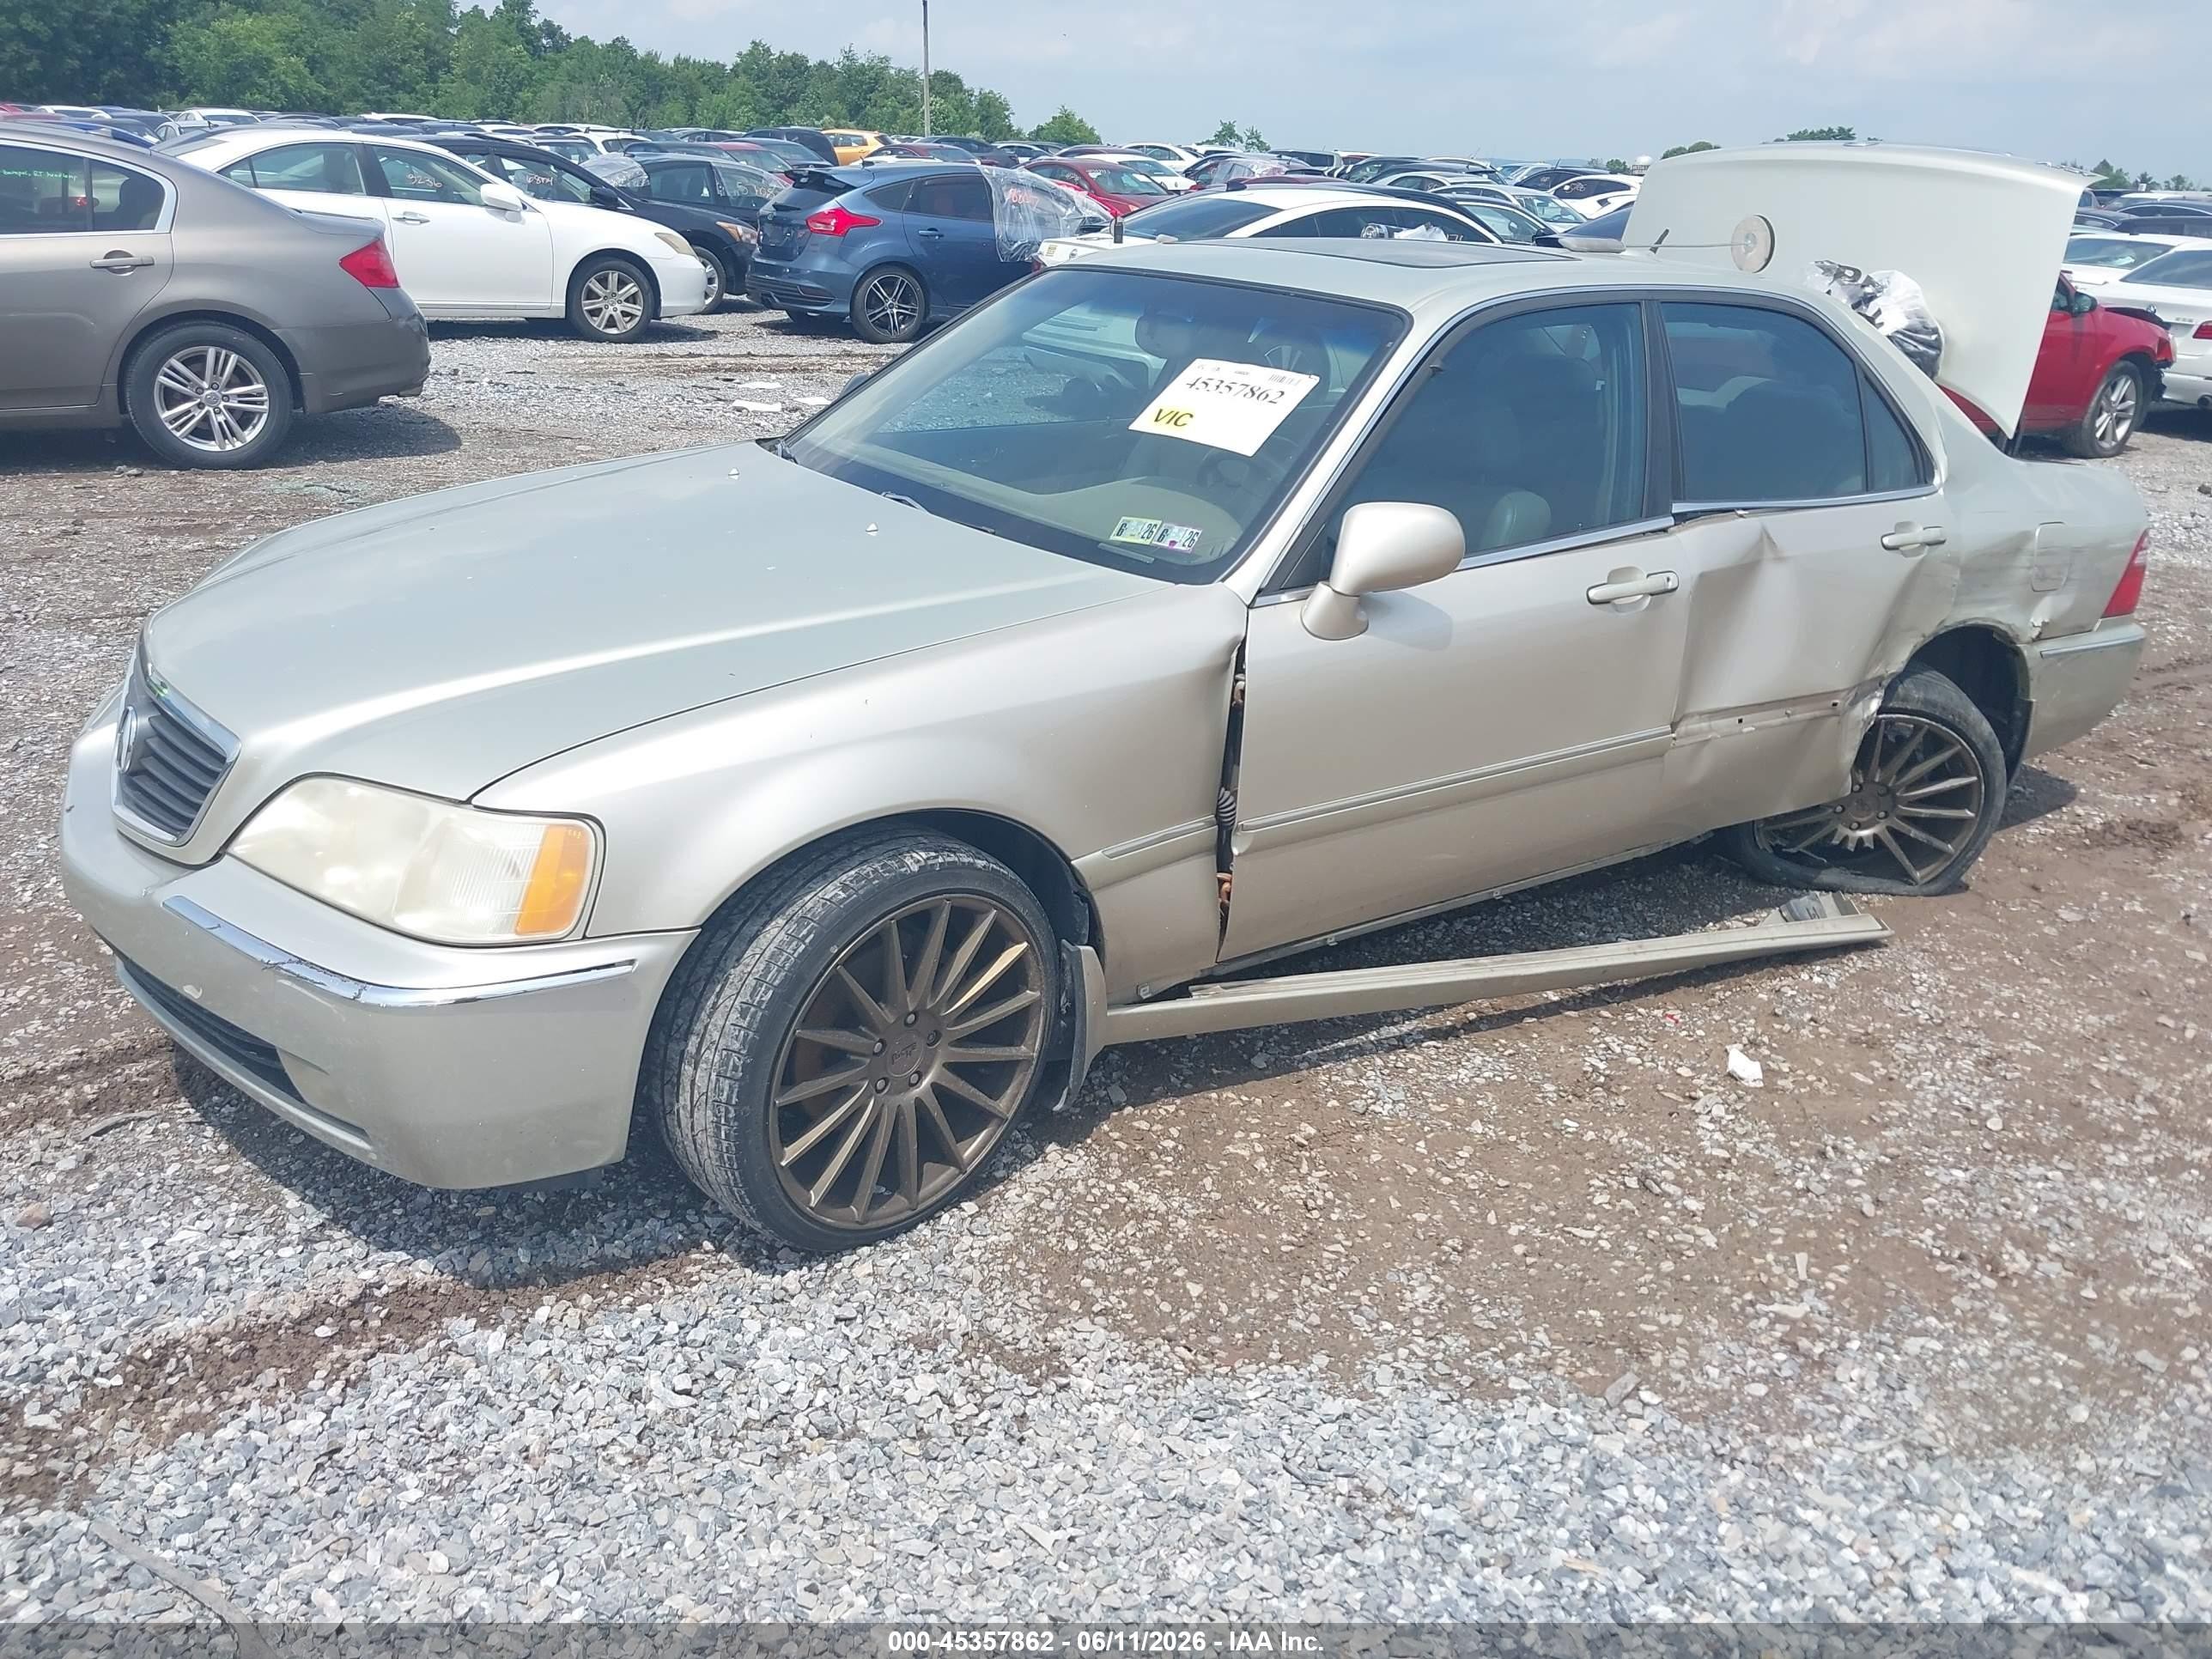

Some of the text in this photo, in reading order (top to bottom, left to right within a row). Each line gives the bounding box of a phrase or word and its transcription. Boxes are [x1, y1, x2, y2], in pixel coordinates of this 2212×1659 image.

[1186, 376, 1285, 404] 45357862
[1153, 408, 1194, 427] VIC
[1141, 523, 1158, 539] 26
[1182, 531, 1200, 548] 26
